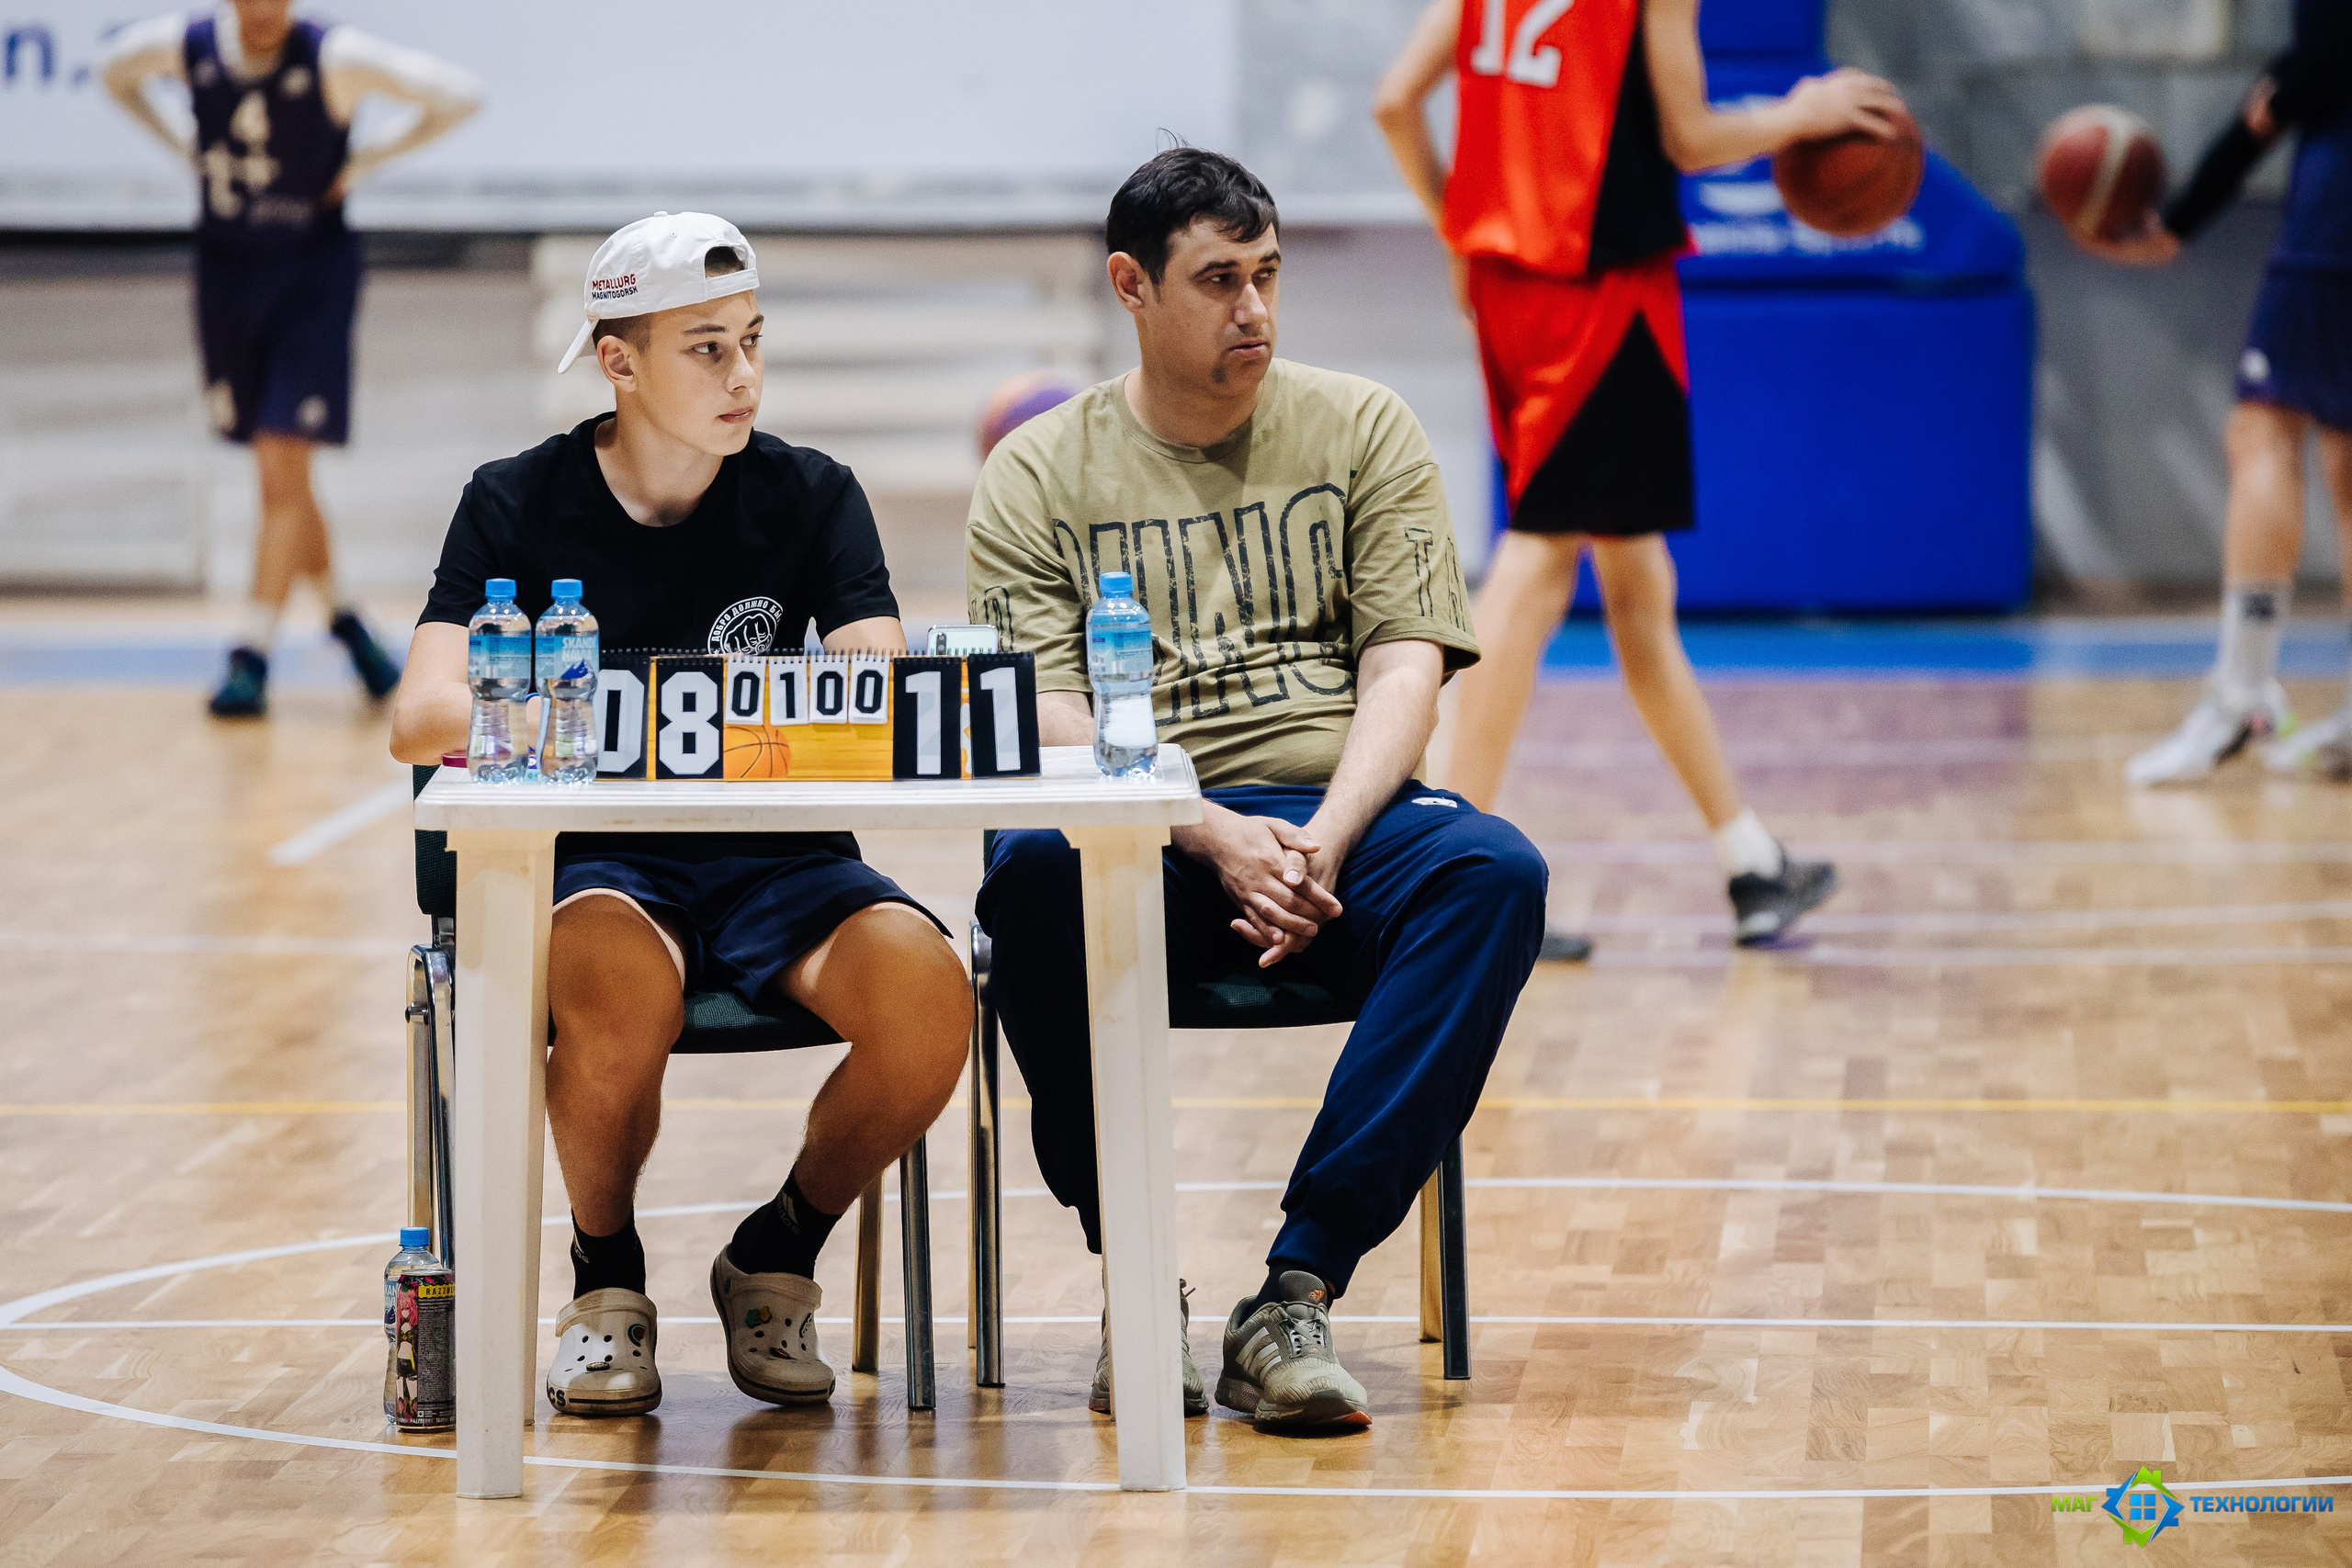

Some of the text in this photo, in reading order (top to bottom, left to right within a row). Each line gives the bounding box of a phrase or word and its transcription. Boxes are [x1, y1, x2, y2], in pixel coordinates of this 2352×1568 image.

[592, 274, 636, 290] METALLURG
[592, 286, 638, 299] MAGNITOGORSK
[711, 600, 782, 642] ДОБРО ДОЛЖНО БЫ
[547, 1381, 566, 1407] CS
